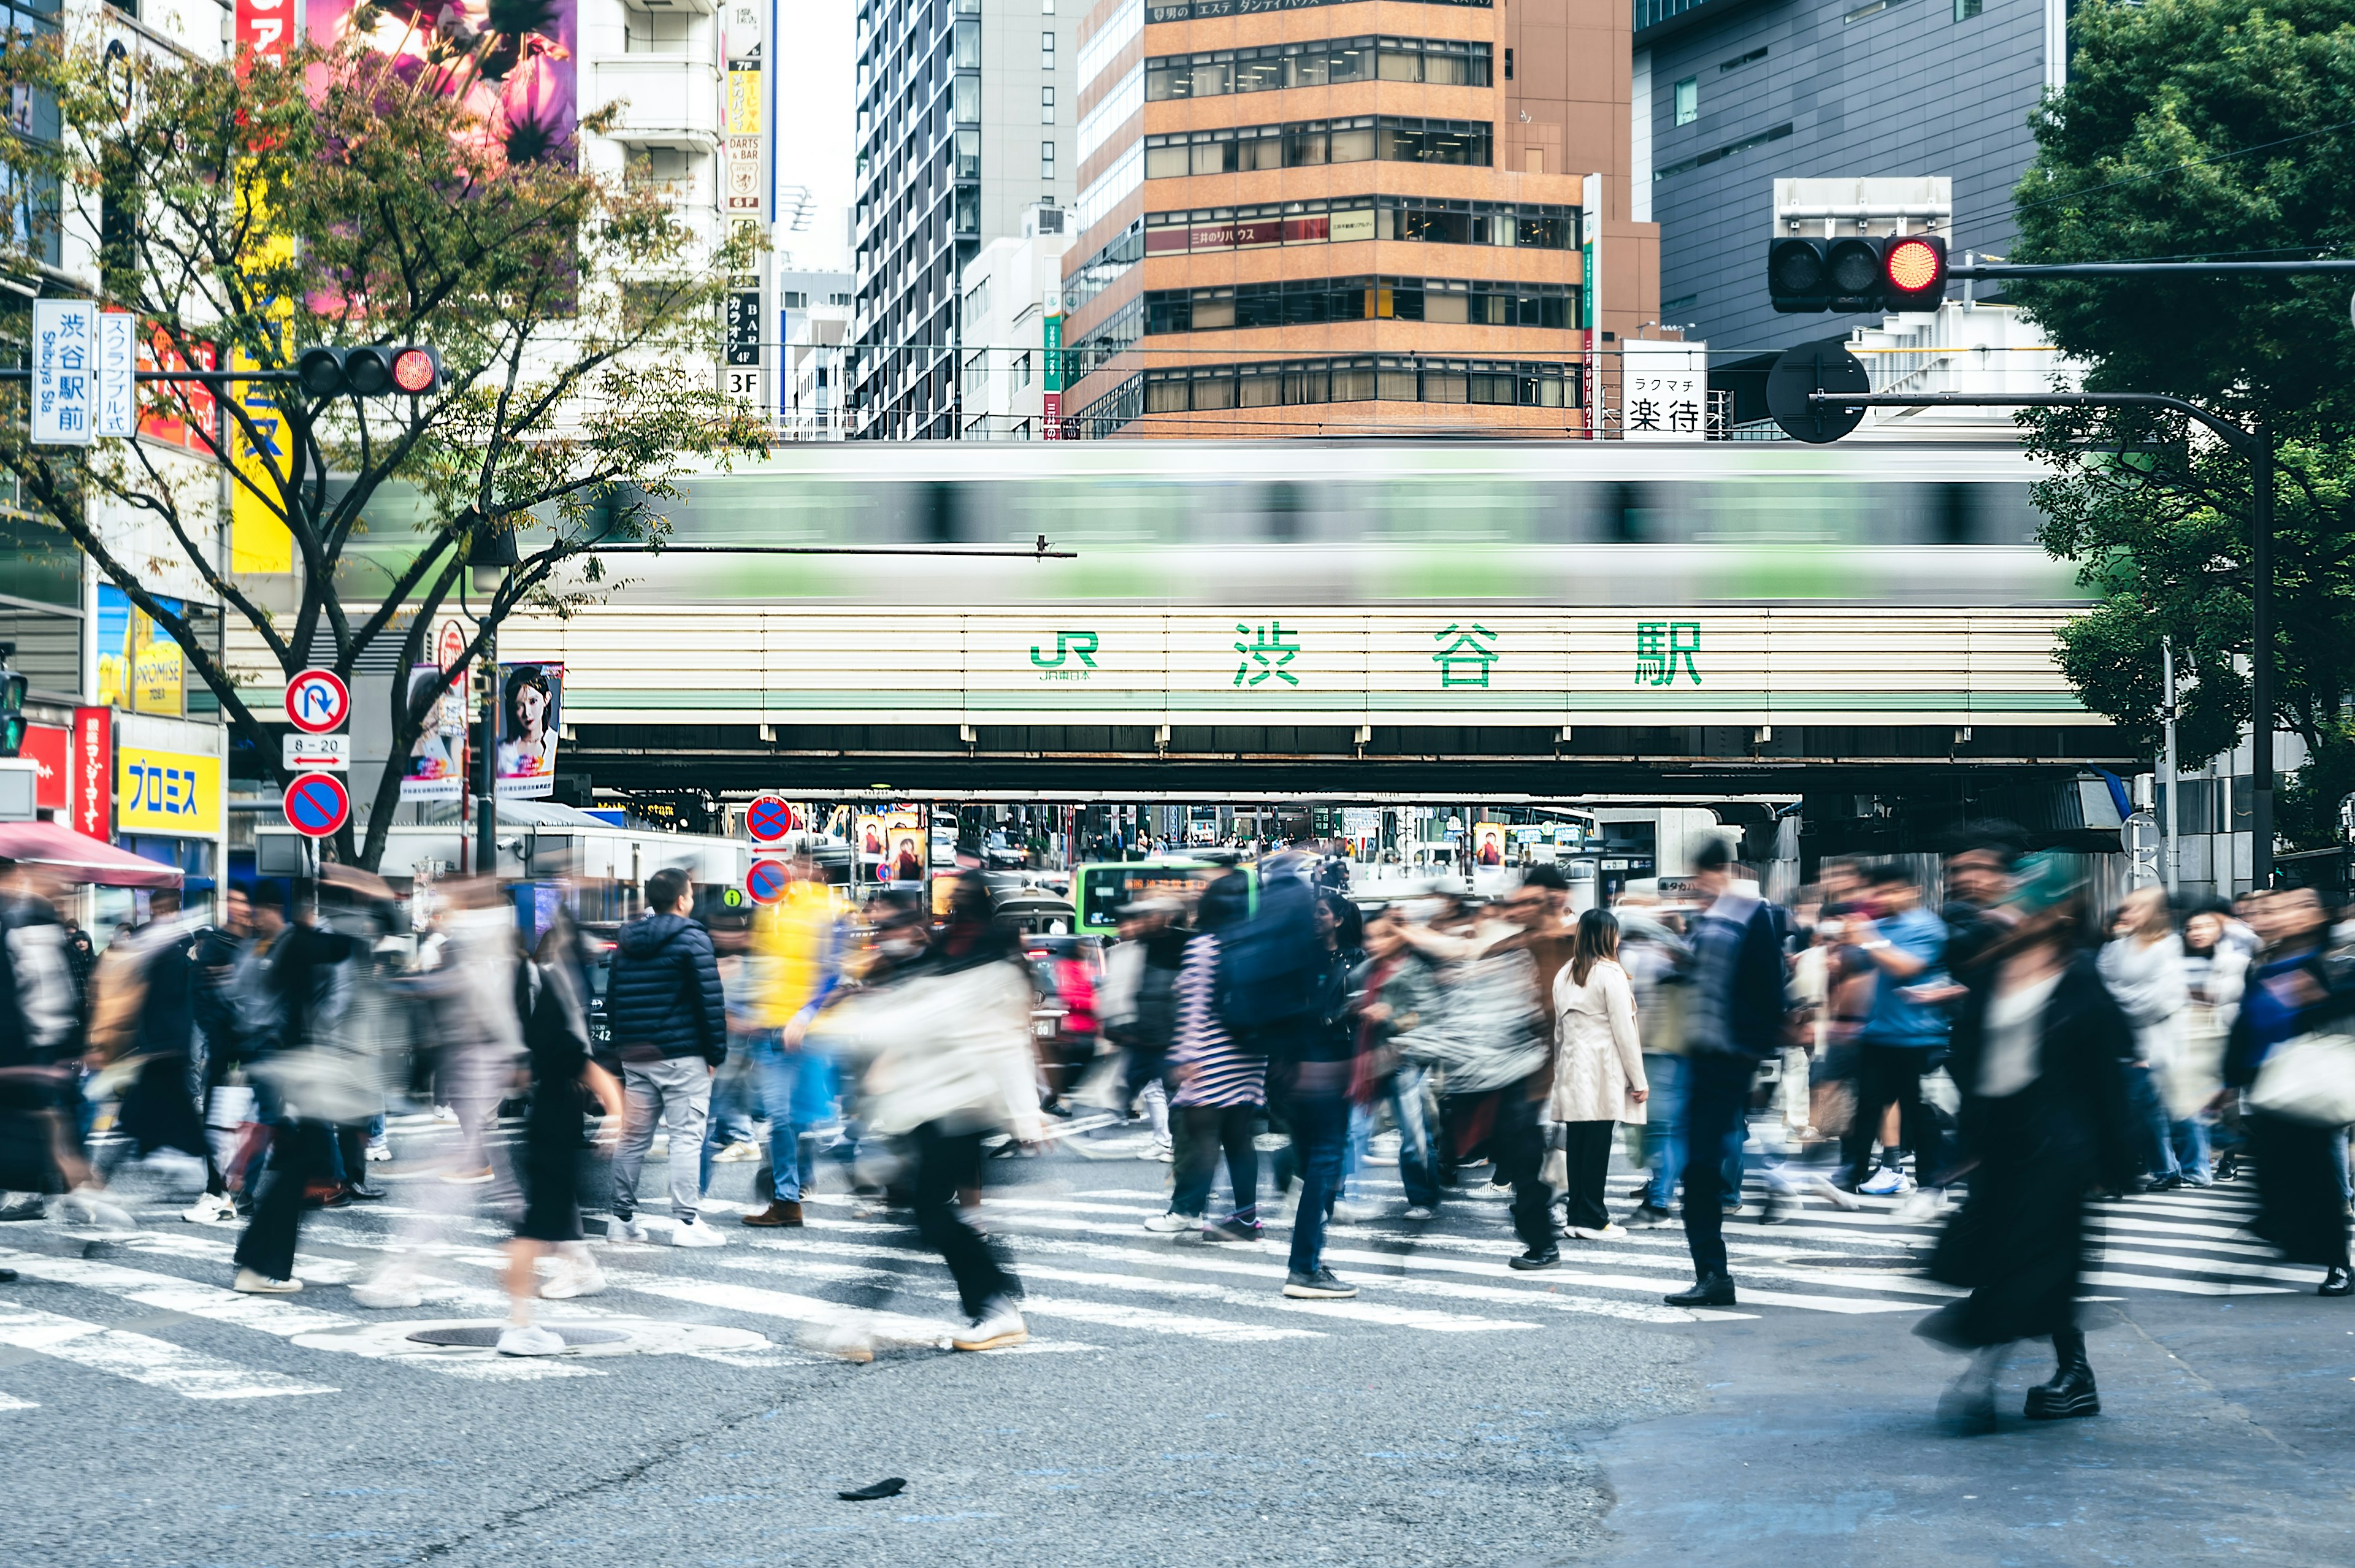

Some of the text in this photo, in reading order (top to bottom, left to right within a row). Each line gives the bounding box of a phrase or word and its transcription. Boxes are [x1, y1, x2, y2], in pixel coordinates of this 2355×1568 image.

[737, 61, 752, 71] 7F
[730, 139, 758, 148] DARTS
[741, 150, 757, 159] BAR
[733, 198, 754, 207] 6F
[1192, 229, 1255, 245] 三井のリハウス
[747, 304, 757, 345] BAR
[737, 351, 749, 362] 4F
[40, 330, 56, 417] Shibuya Sta.
[59, 313, 85, 431] 渋谷駅前
[106, 319, 125, 431] スクランブル式
[730, 374, 757, 392] 3F
[1635, 378, 1694, 392] ラクマチ
[1047, 403, 1056, 440] 三井の
[1629, 397, 1699, 433] 楽待
[1030, 630, 1098, 668] JR
[1233, 621, 1702, 687] 渋谷駅
[136, 660, 179, 687] PROMISE
[1039, 670, 1091, 681] JR東日本
[129, 758, 197, 816] プロミス
